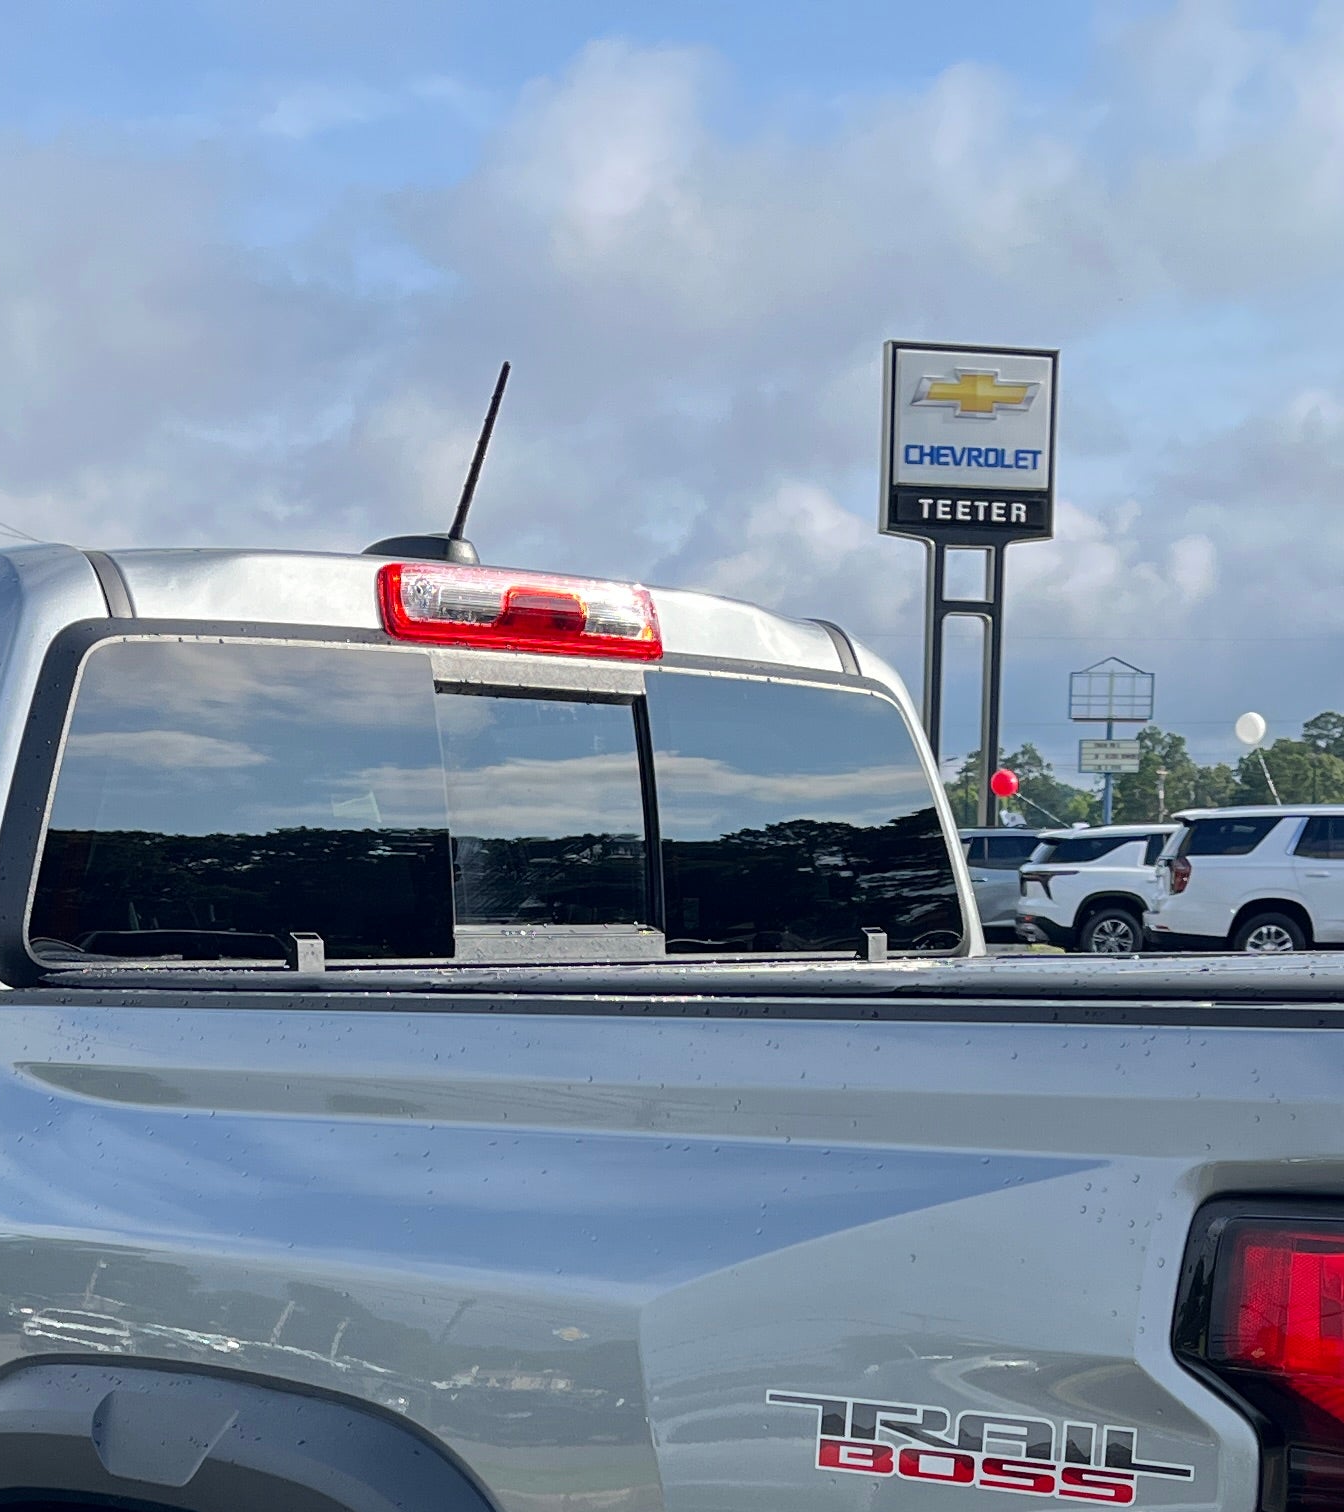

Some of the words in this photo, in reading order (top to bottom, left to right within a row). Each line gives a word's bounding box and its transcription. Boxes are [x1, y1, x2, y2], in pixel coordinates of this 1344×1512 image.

[904, 444, 1042, 470] CHEVROLET
[918, 498, 1027, 523] TEETER
[766, 1389, 1194, 1481] TRAIL
[815, 1438, 1138, 1507] BOSS
